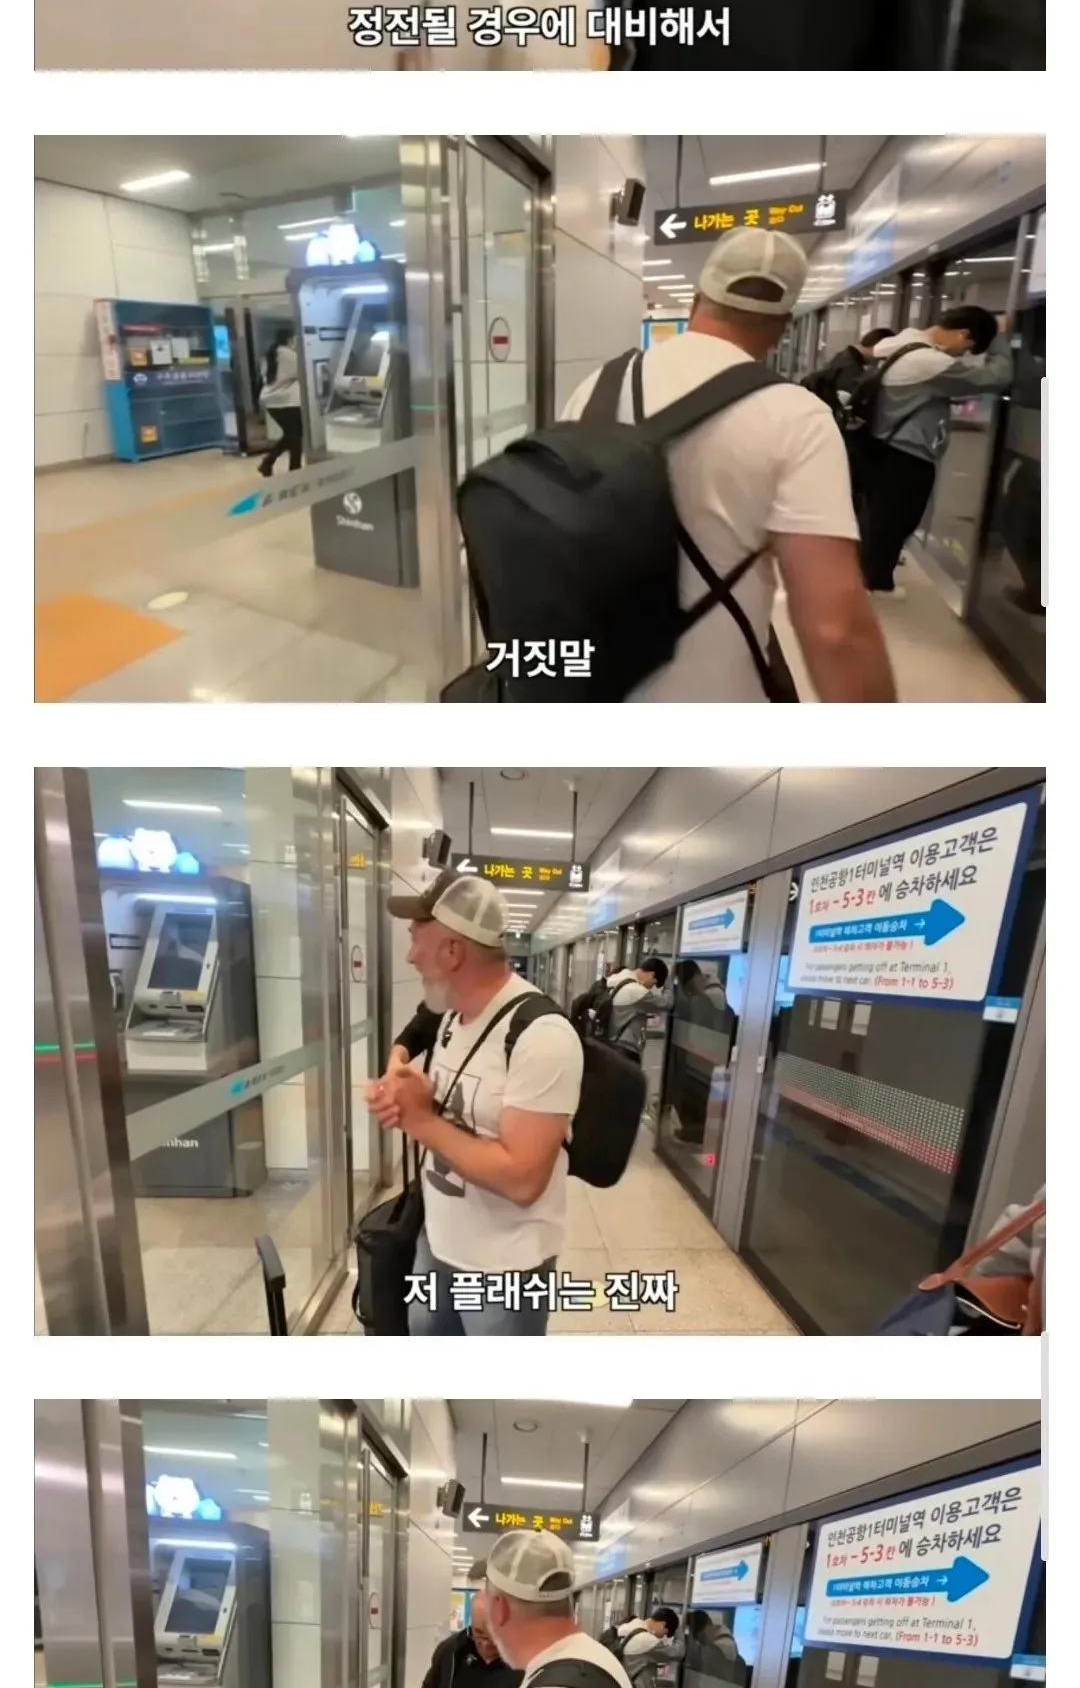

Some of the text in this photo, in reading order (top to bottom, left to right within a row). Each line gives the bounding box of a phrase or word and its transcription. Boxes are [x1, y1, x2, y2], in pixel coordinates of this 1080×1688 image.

[694, 213, 735, 230] 나가는
[744, 209, 760, 226] 곳
[909, 826, 998, 865] 이용고객은
[484, 863, 516, 878] 나가는
[895, 864, 978, 901] 승차하세요
[900, 961, 941, 973] Terminal
[930, 1486, 1022, 1526] 이용고객은
[916, 1523, 1001, 1557] 승차하세요
[896, 1616, 909, 1626] off
[910, 1618, 919, 1627] at
[922, 1617, 963, 1629] Terminal
[895, 1630, 920, 1643] (From
[924, 1631, 938, 1643] 1-1
[941, 1631, 952, 1644] to
[955, 1632, 978, 1647] 5-3)
